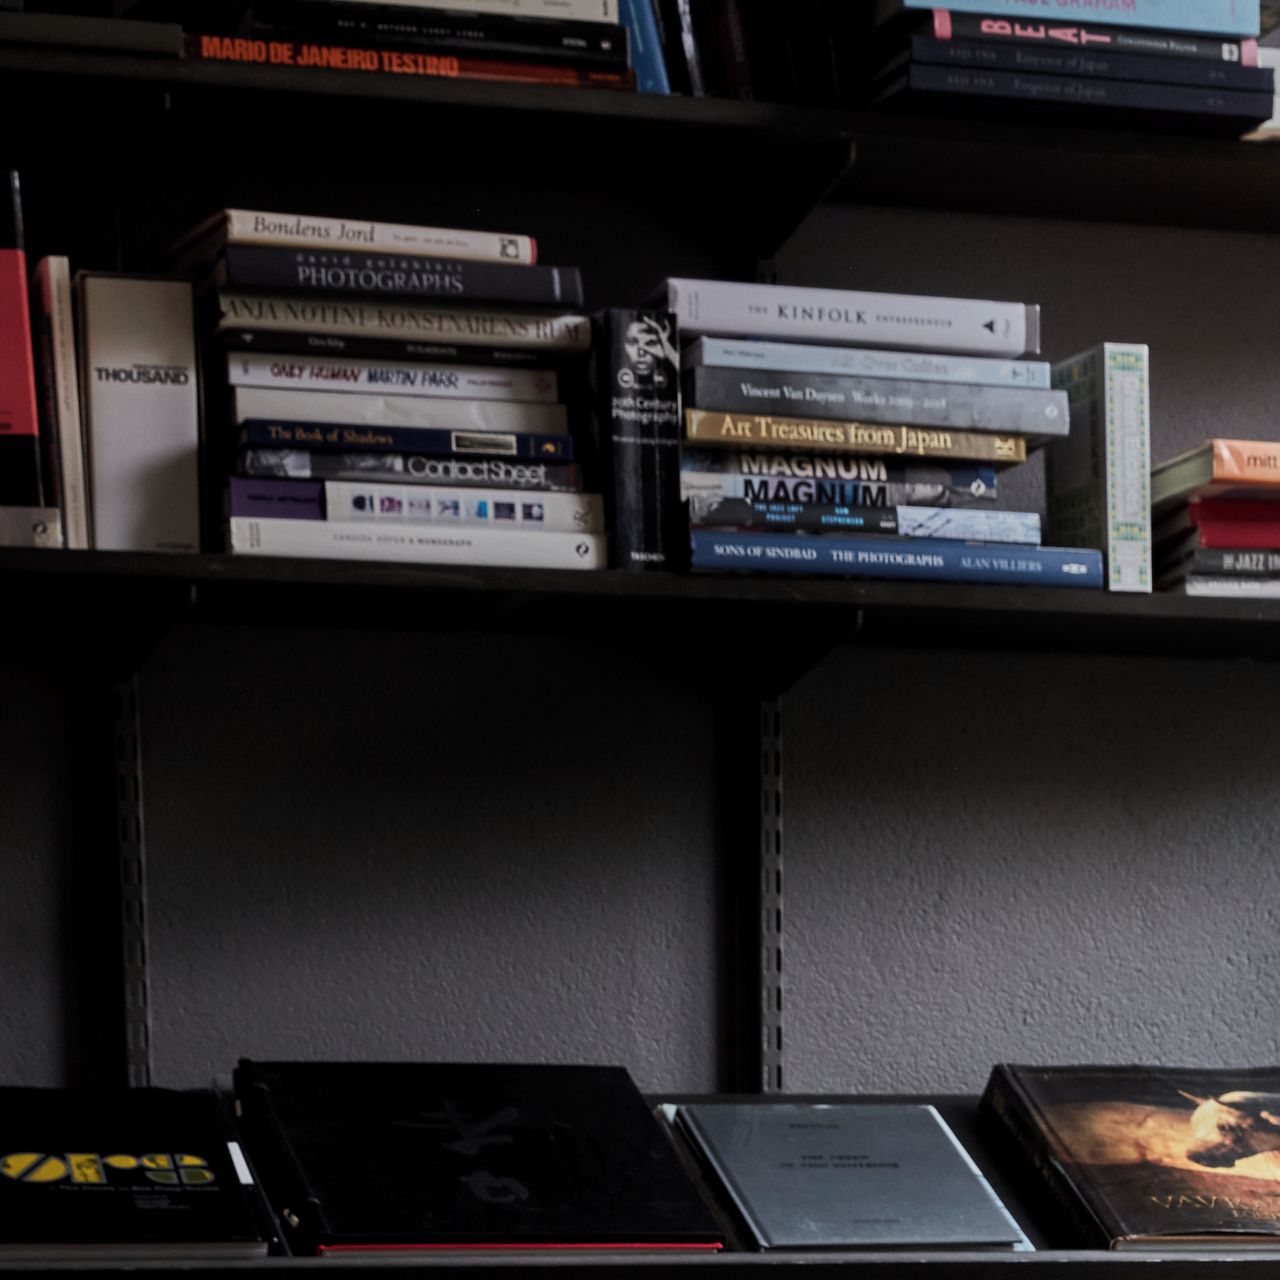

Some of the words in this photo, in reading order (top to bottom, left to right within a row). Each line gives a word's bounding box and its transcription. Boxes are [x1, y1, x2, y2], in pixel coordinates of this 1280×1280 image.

[201, 34, 267, 63] MARIO
[268, 41, 295, 65] DE
[296, 44, 379, 71] JANEIRO
[382, 51, 460, 78] TESTINO
[254, 215, 331, 239] Bondens
[335, 222, 375, 245] Jord
[297, 266, 464, 294] PHOTOGRAPHS
[229, 298, 276, 320] ANJA
[777, 304, 868, 324] KINFOLK
[95, 367, 189, 385] THOUSAND
[367, 368, 418, 387] MARTIN
[421, 371, 459, 388] PARR
[721, 415, 753, 437] Art
[756, 417, 845, 442] Treasures
[851, 424, 895, 446] from
[897, 429, 953, 454] Japan
[408, 455, 489, 479] Contact
[489, 460, 548, 487] Sheet
[740, 454, 888, 482] MAGNUM
[1247, 455, 1277, 470] mitt
[742, 478, 888, 507] MAGNUM
[714, 543, 745, 558] SONS
[747, 545, 763, 559] OF
[765, 546, 817, 561] SINDBAD
[830, 549, 853, 563] THE
[857, 551, 944, 567] PHOTOGRAPHS
[960, 557, 989, 570] ALAN
[992, 559, 1042, 573] VILLIERS
[1235, 554, 1265, 571] JAZZ
